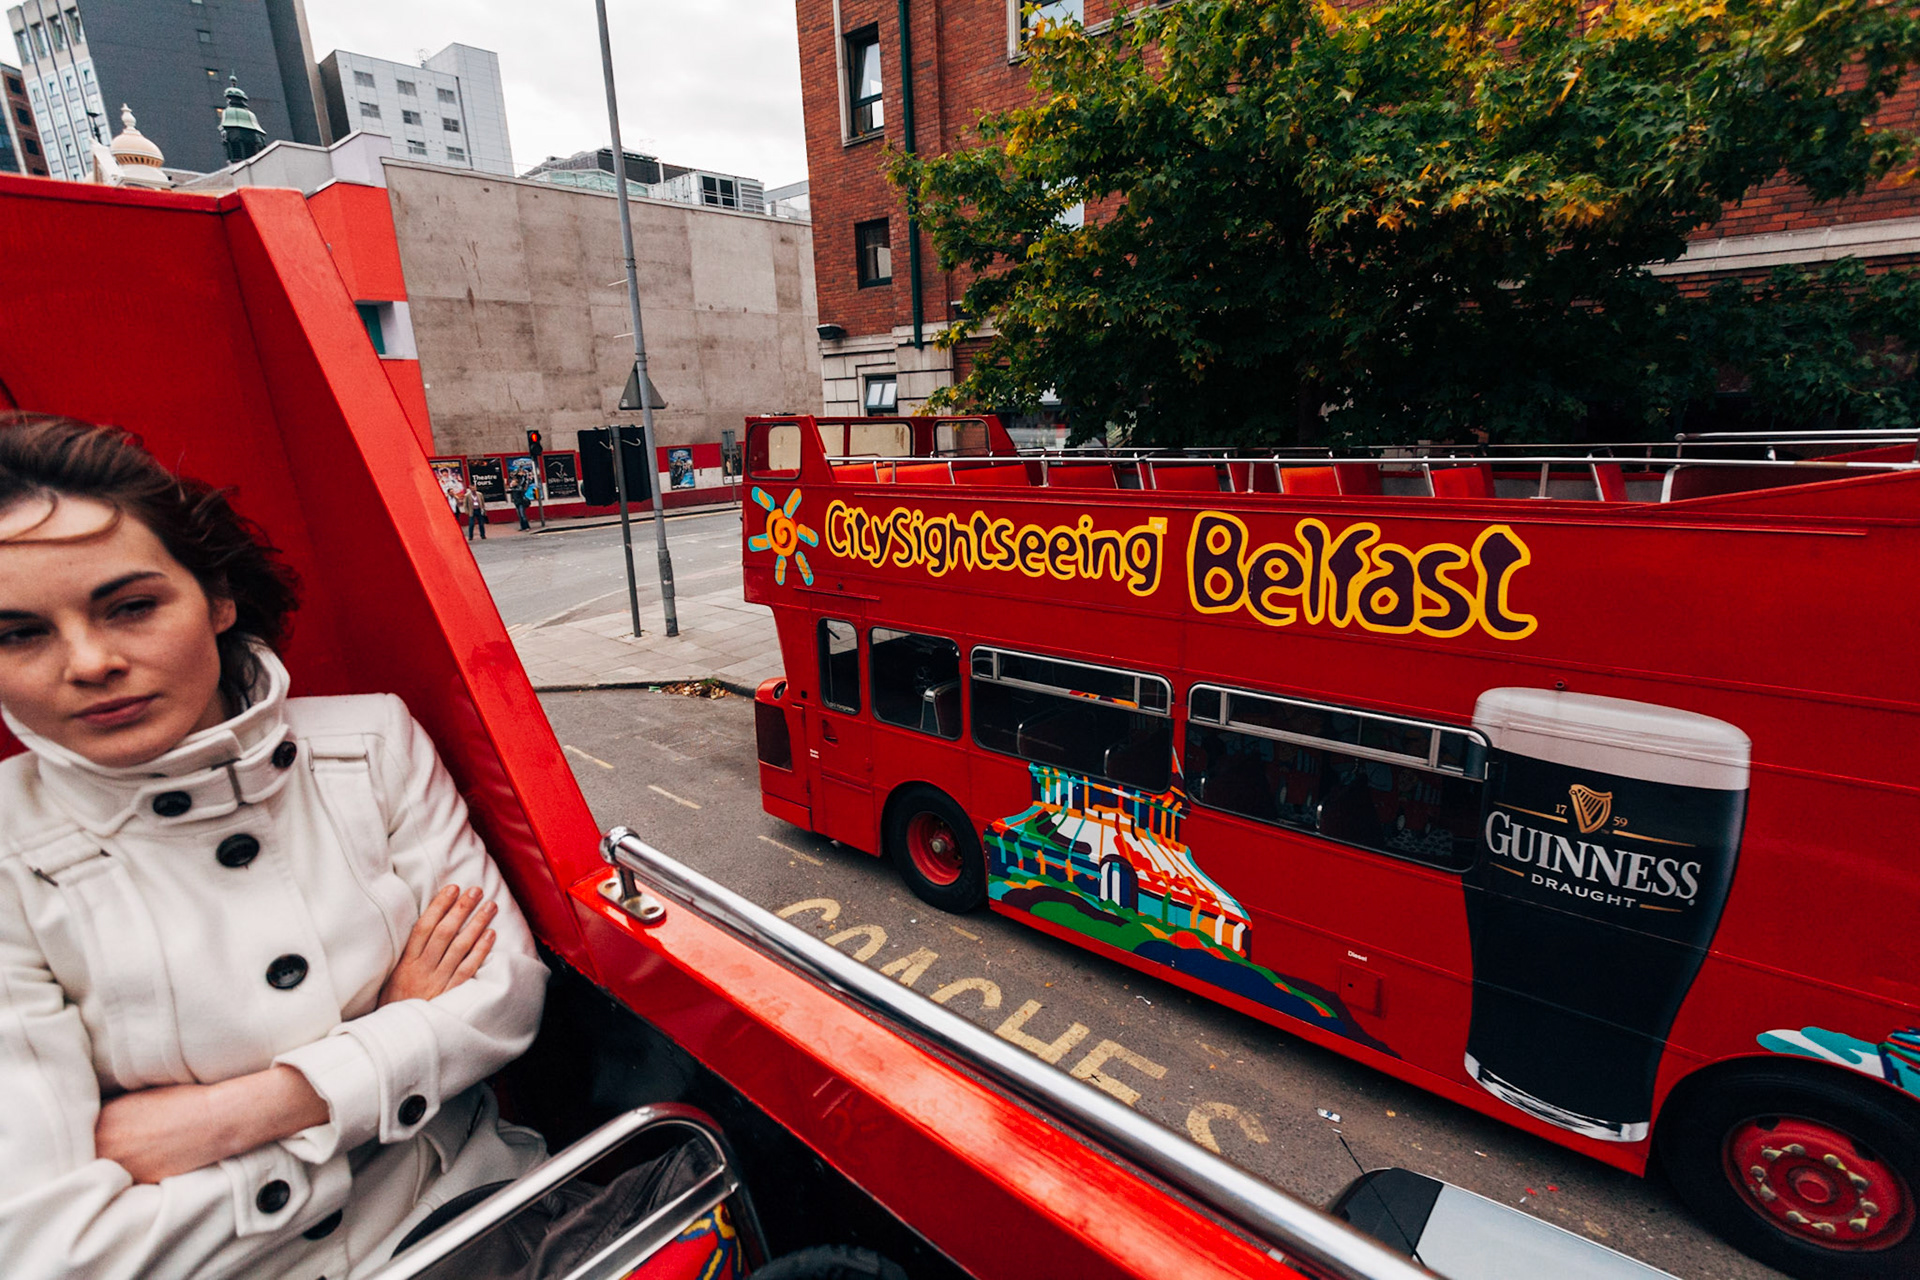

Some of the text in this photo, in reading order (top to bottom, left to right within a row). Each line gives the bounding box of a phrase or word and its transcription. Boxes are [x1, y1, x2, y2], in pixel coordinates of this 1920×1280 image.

[825, 500, 1538, 640] CitySightseeing Belfast
[1555, 803, 1628, 827] 17 59
[1485, 811, 1701, 899] GUINNESS
[1531, 873, 1636, 908] DRAUGHT
